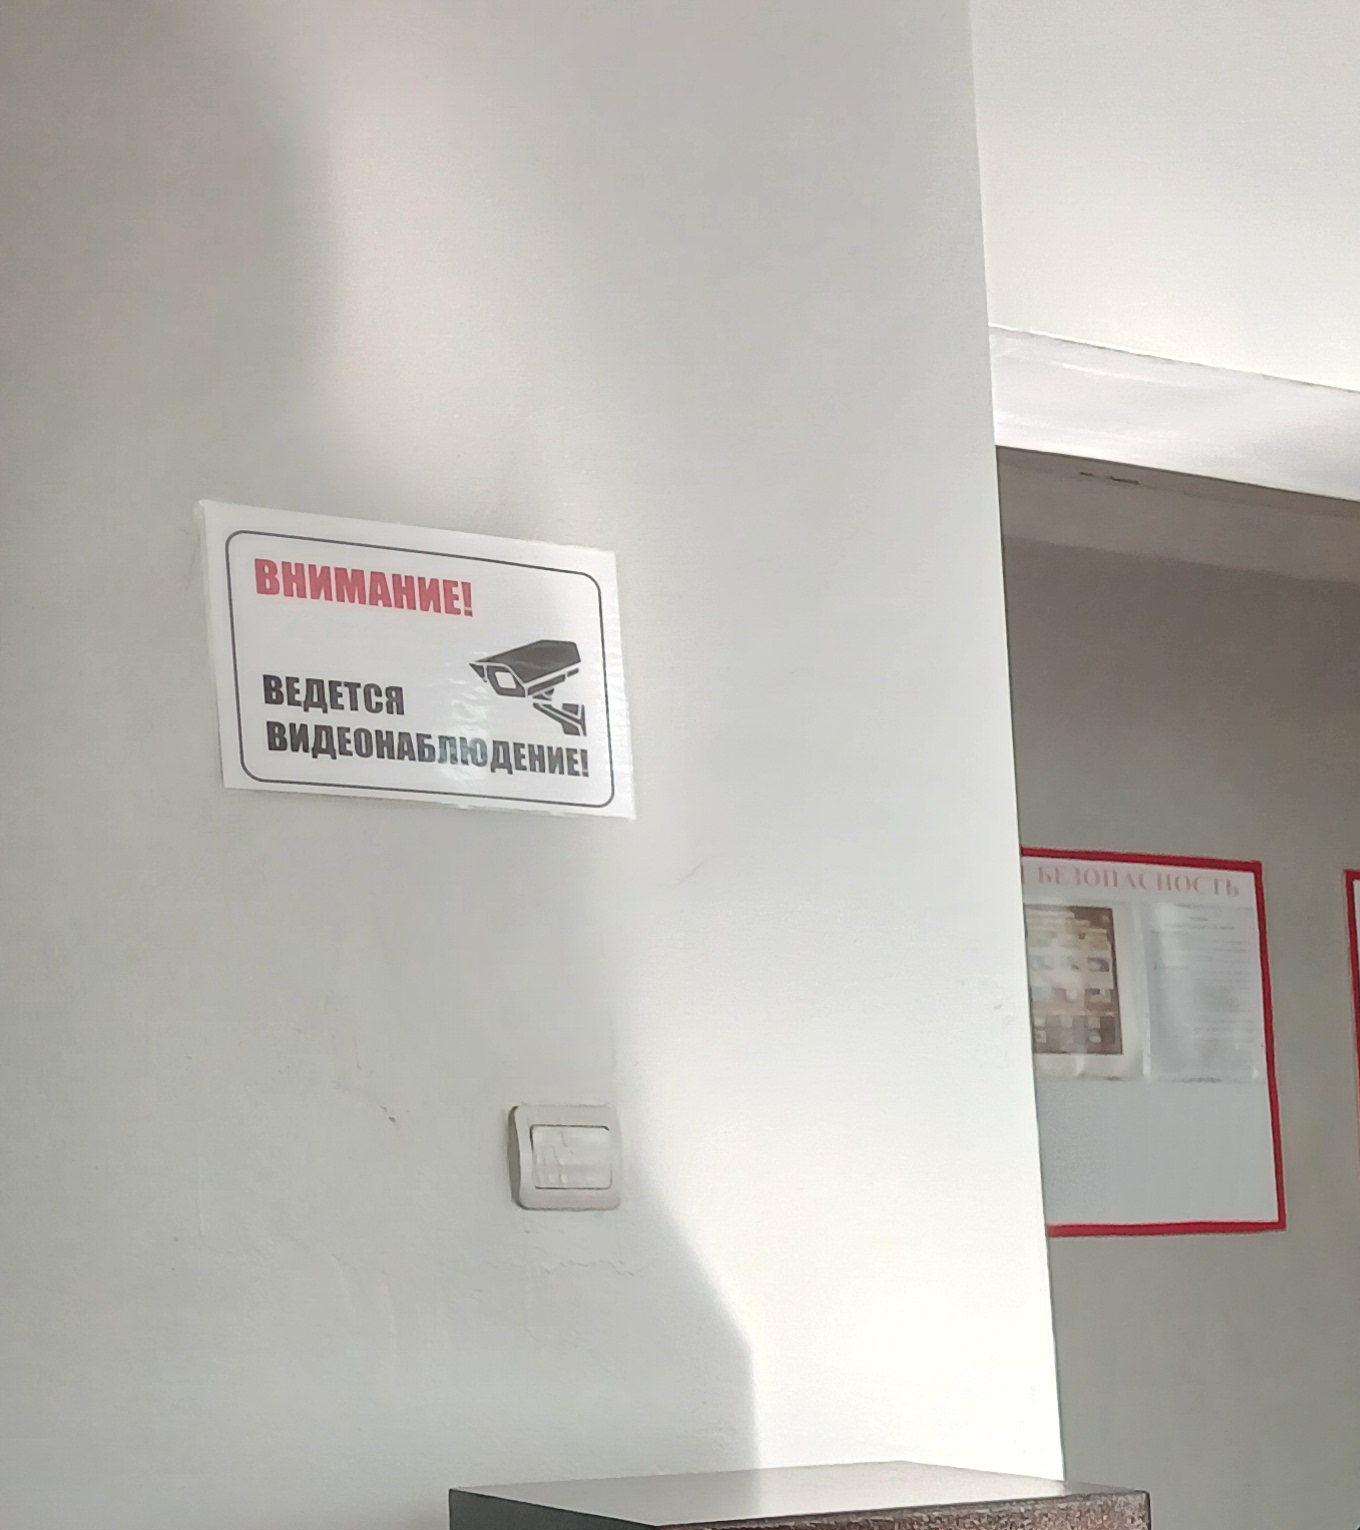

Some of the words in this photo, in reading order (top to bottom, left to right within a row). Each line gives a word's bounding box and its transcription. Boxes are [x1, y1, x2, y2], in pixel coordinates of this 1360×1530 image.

[253, 558, 474, 617] ВНИМАНИЕ!
[262, 673, 405, 716] ВЕДЕТСЯ
[265, 720, 590, 778] ВИДЕОНАБЛЮДЕНИЕ!
[1038, 864, 1240, 898] БЕЗОПАСНОСТЬ
